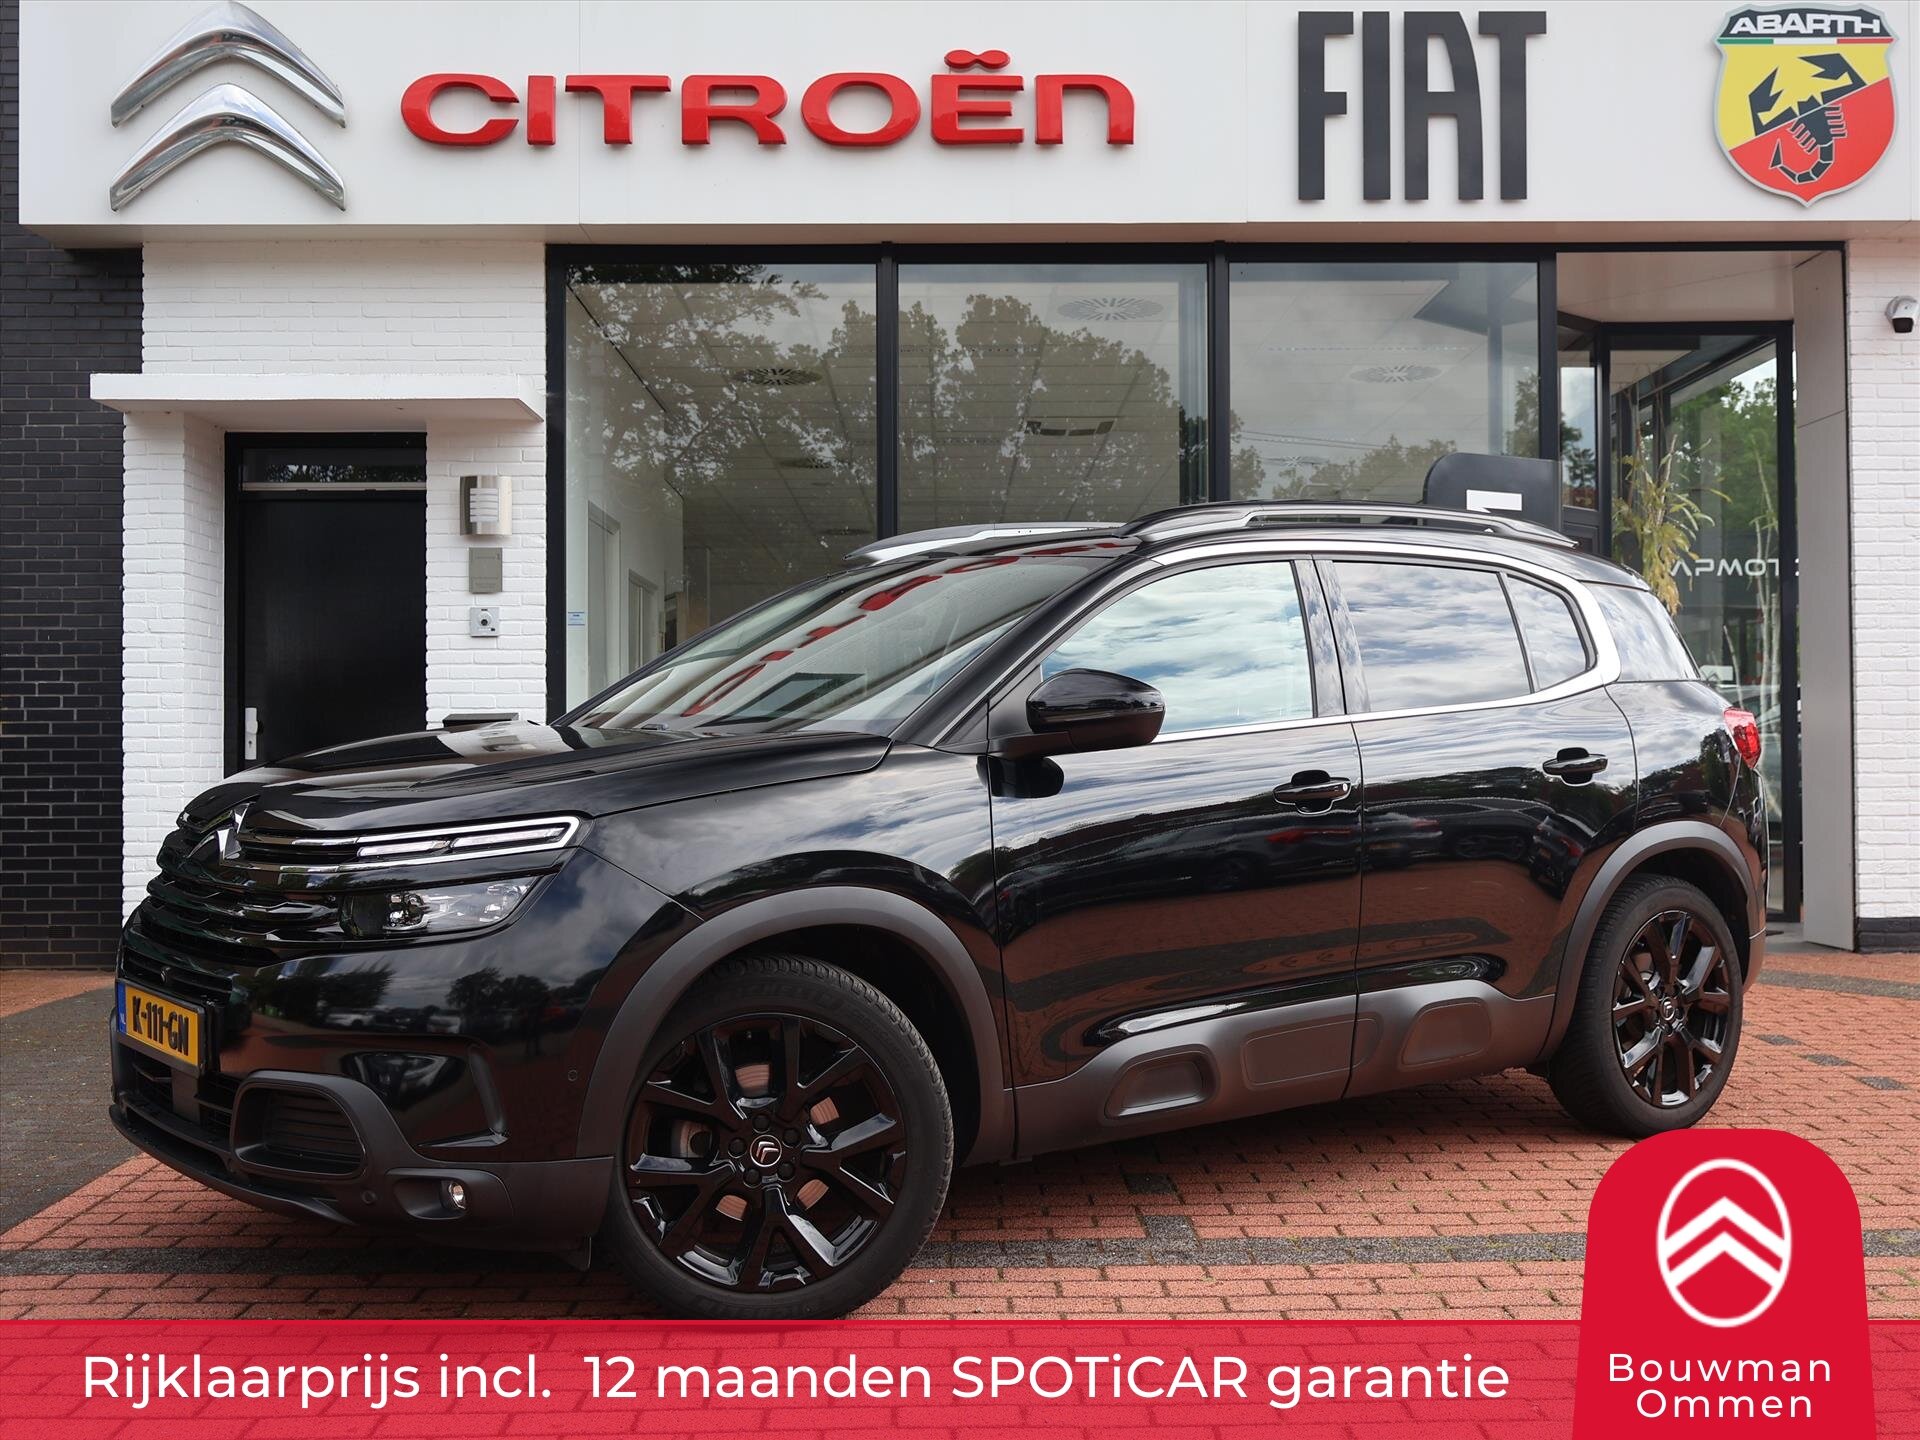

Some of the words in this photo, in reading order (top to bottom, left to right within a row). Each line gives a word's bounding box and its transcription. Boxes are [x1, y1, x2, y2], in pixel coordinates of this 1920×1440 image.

[1729, 12, 1881, 35] ABARTH
[401, 49, 1135, 147] CITROËN
[1299, 12, 1546, 201] FIAT
[132, 995, 189, 1056] K-111-GN
